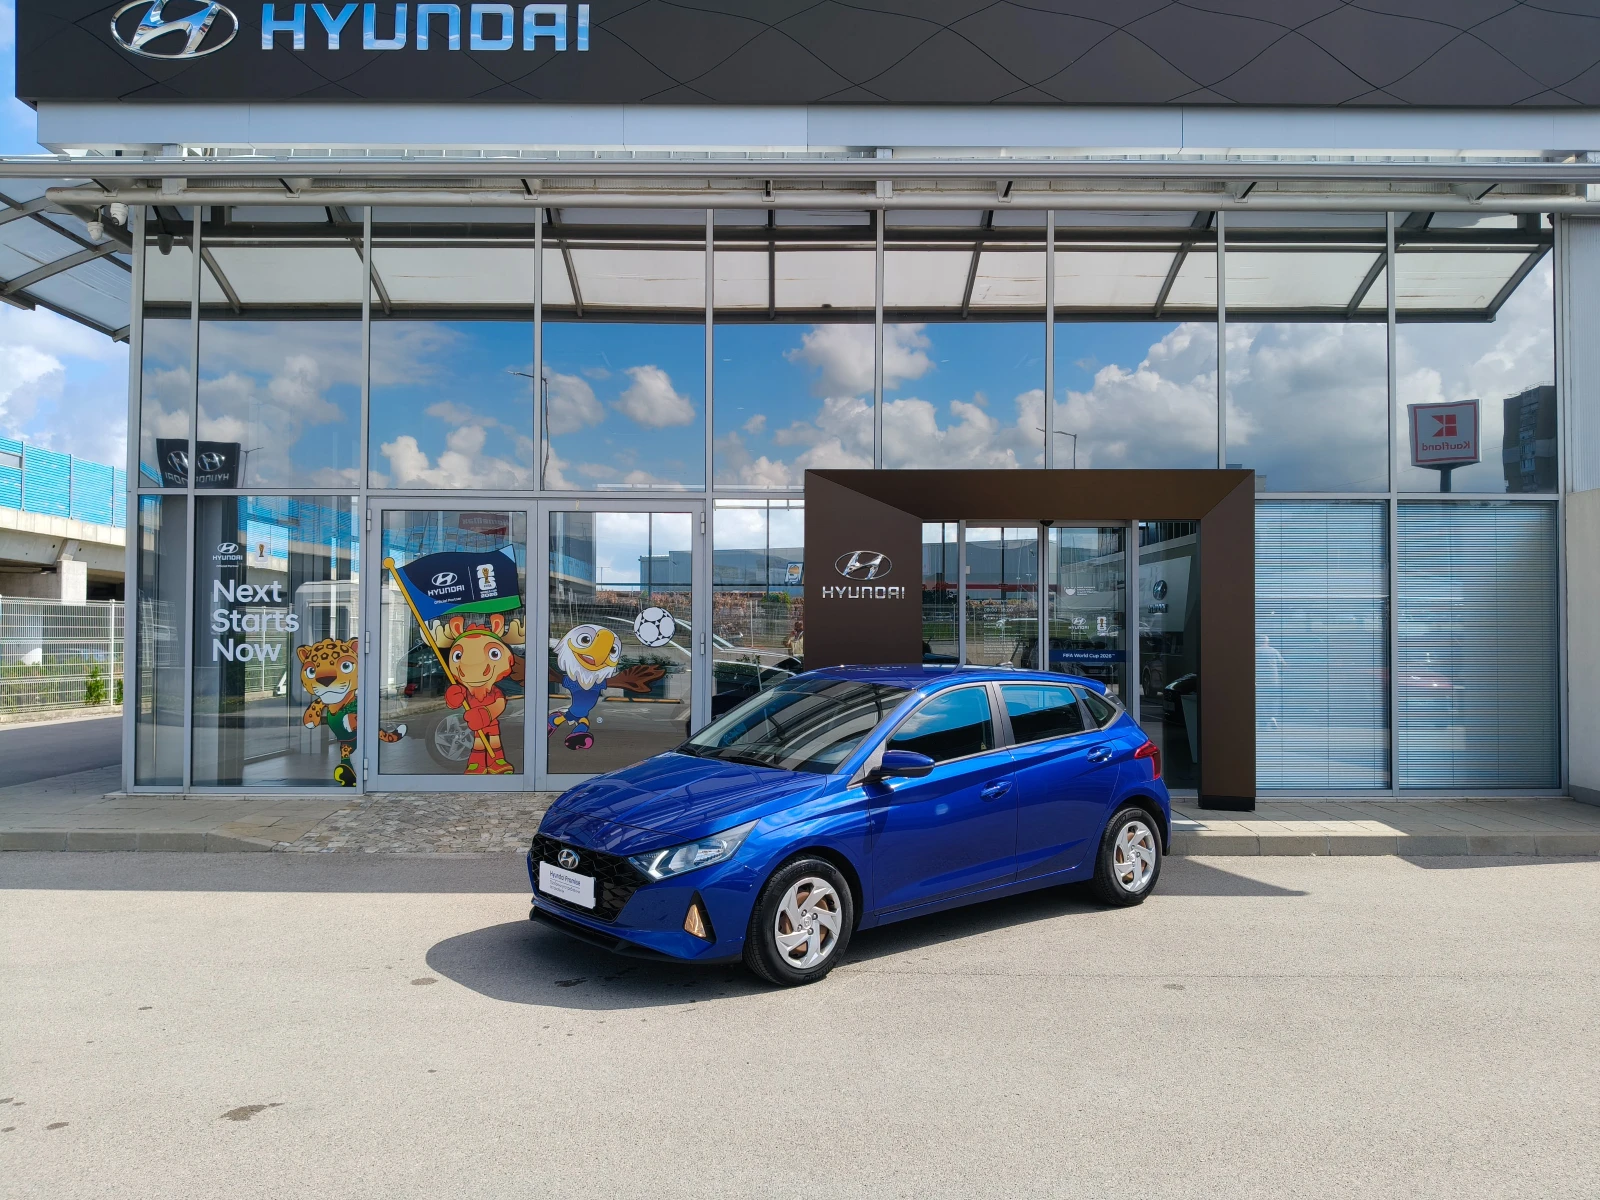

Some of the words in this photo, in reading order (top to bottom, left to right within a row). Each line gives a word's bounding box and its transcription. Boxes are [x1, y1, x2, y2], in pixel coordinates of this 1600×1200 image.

[261, 3, 589, 51] HYUNDAI
[213, 579, 282, 603] Next
[428, 585, 465, 596] HYUNDAI
[822, 586, 905, 599] HYUNDAI
[211, 608, 300, 632] Starts
[212, 638, 282, 662] Now
[550, 871, 564, 880] Hyundai
